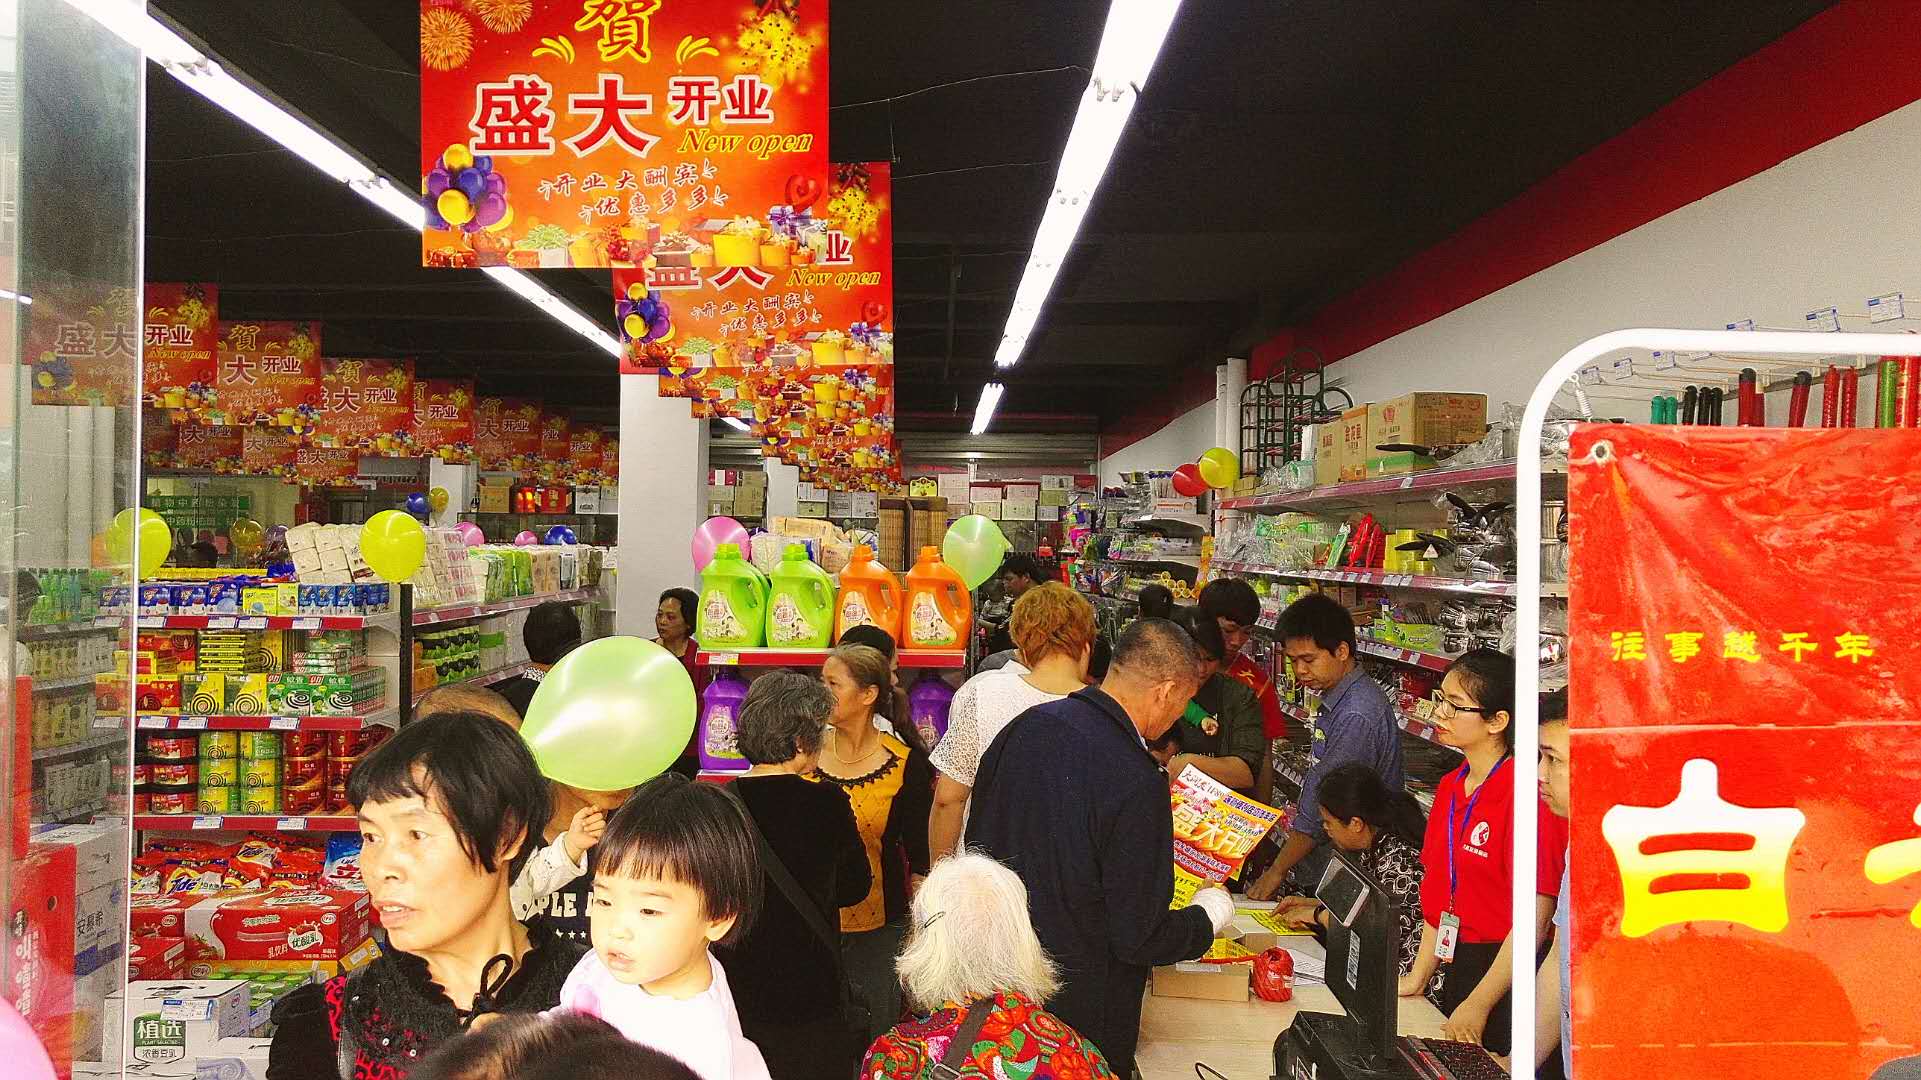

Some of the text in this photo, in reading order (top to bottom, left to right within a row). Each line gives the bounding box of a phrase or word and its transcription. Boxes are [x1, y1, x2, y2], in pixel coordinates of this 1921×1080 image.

[470, 73, 773, 157] 盛大开业
[678, 128, 813, 158] New open
[554, 162, 697, 193] 开业大酬宾
[594, 188, 709, 217] 优惠多多
[788, 269, 829, 286] New
[835, 271, 880, 290] open
[701, 293, 801, 318] 开业大酬宾
[730, 311, 808, 331] 优惠多多
[1611, 631, 1874, 663] 往事越千年
[137, 1019, 183, 1040] 植选
